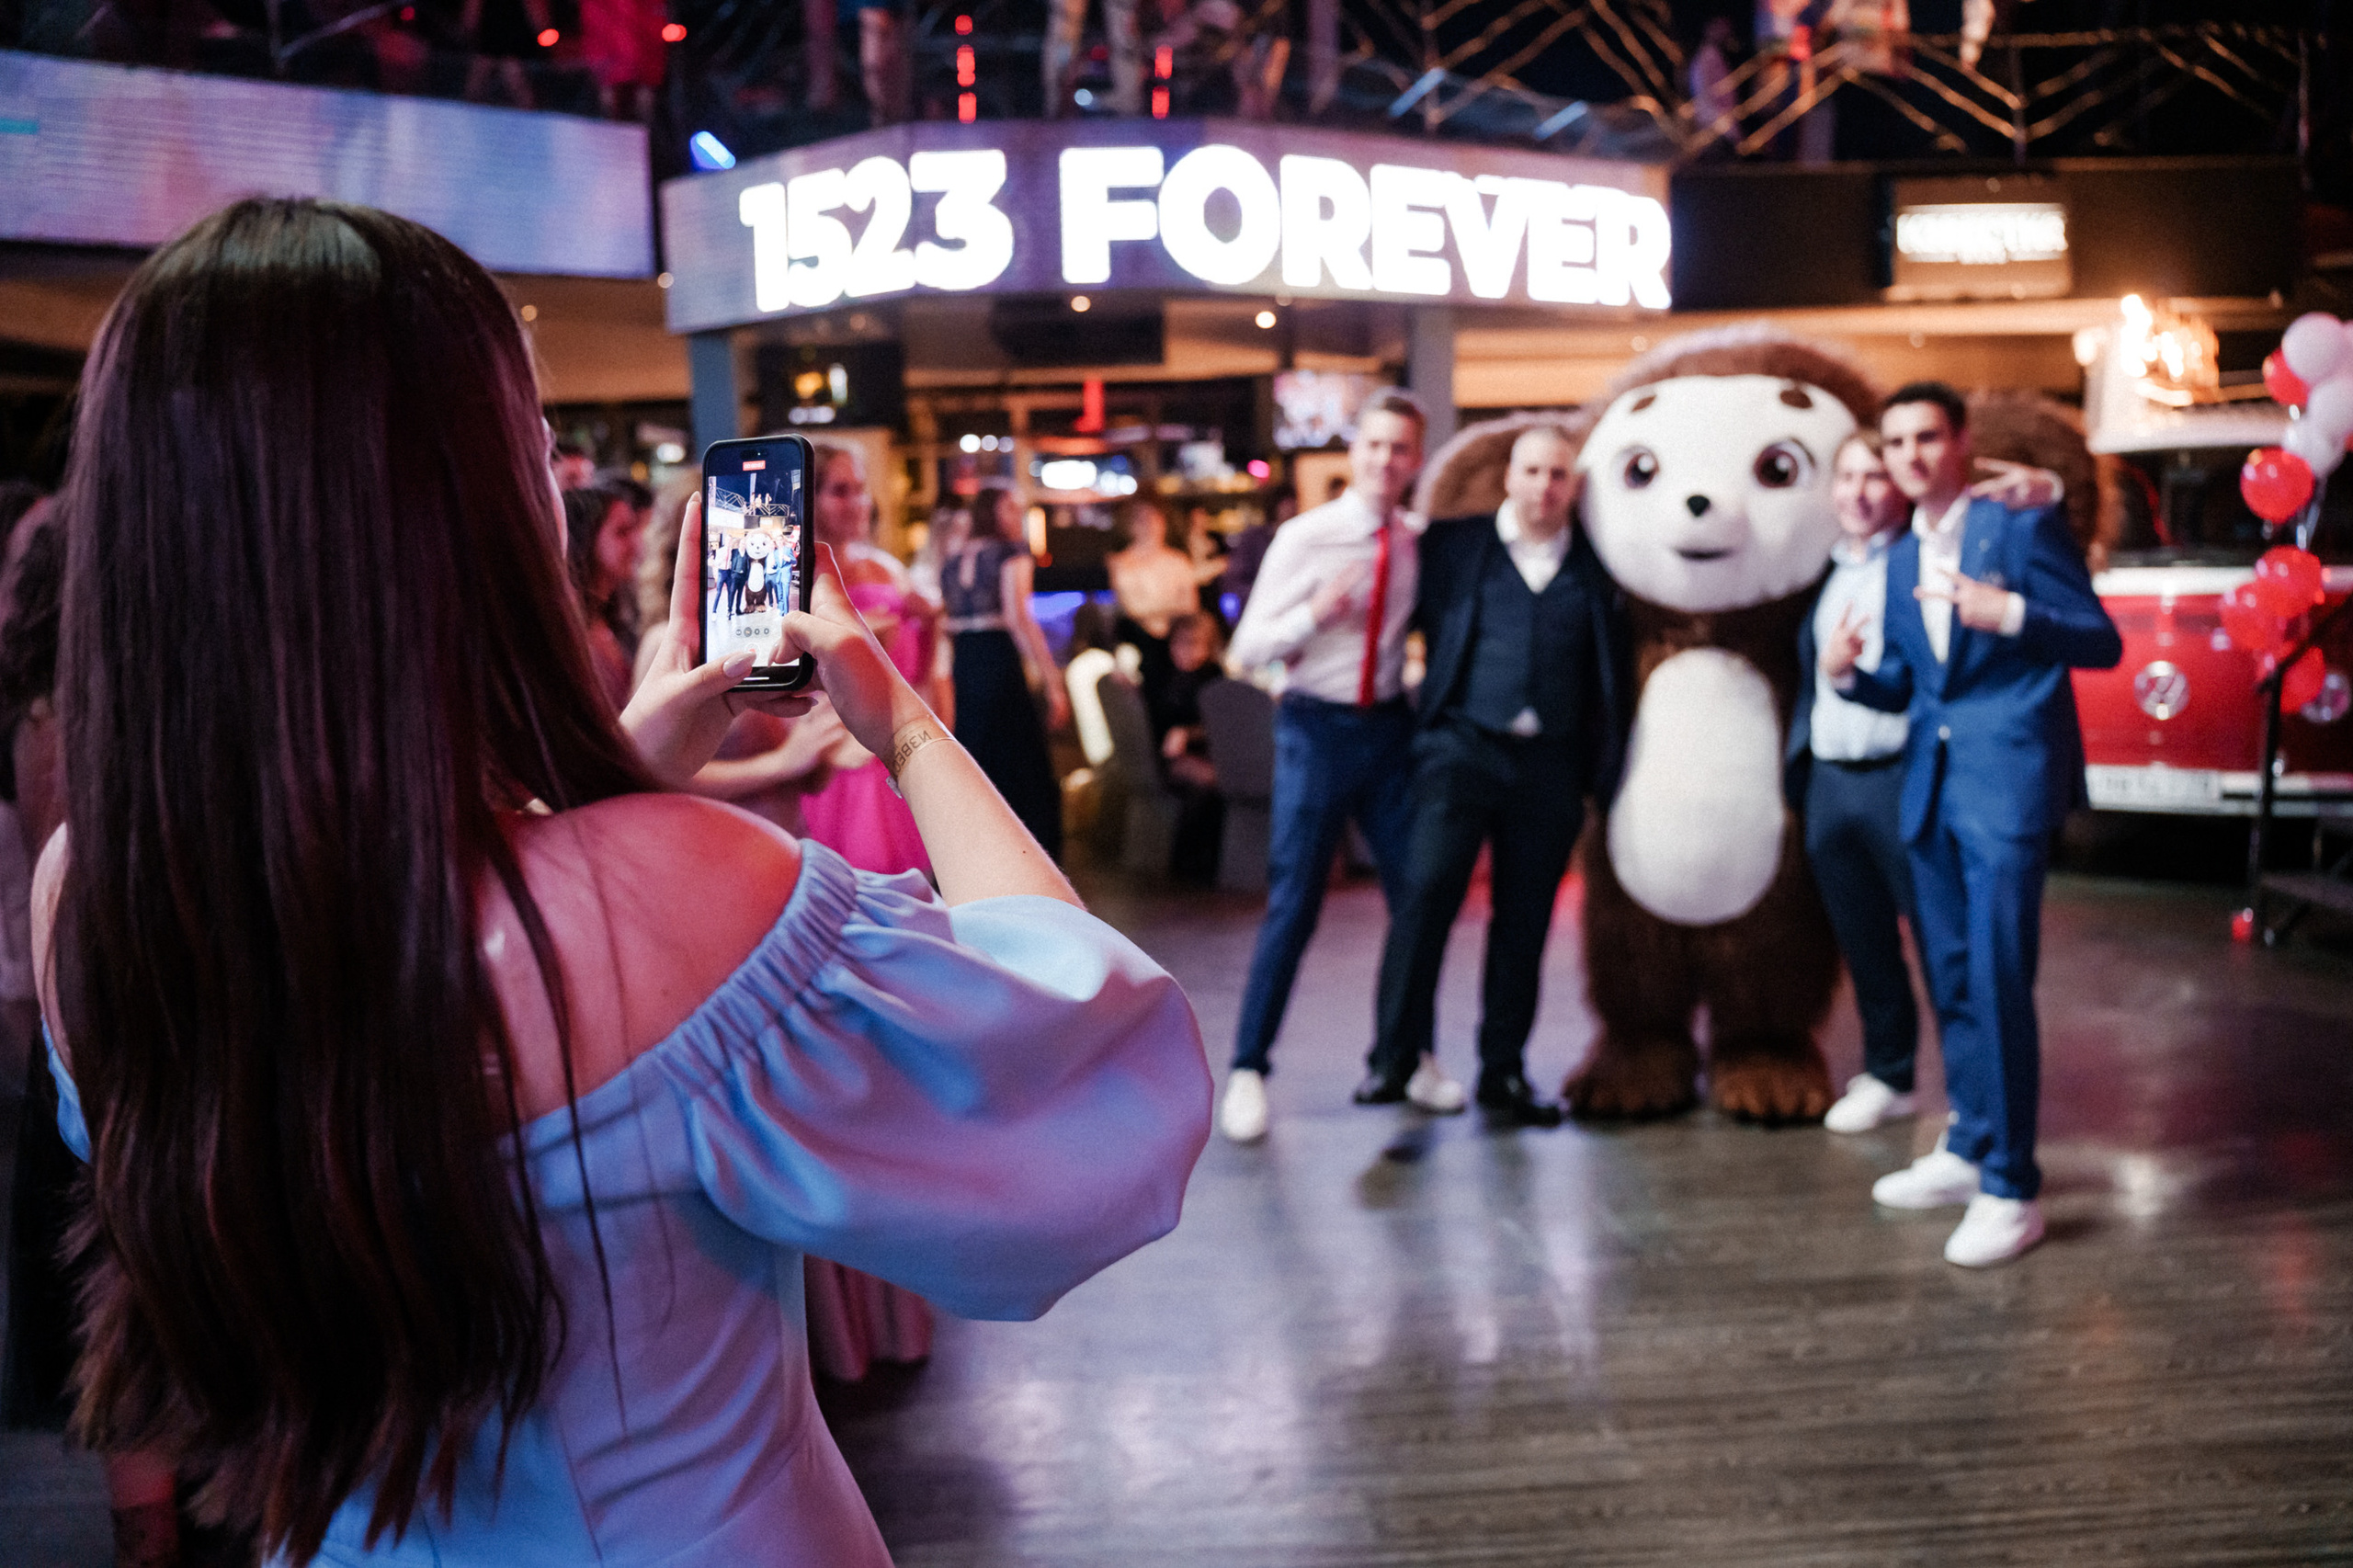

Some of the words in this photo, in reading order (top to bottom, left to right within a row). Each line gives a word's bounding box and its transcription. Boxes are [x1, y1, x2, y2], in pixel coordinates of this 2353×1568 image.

[739, 150, 1013, 312] 1523
[1060, 144, 1671, 310] FOREVER
[892, 730, 932, 774] ИЗВЕС
